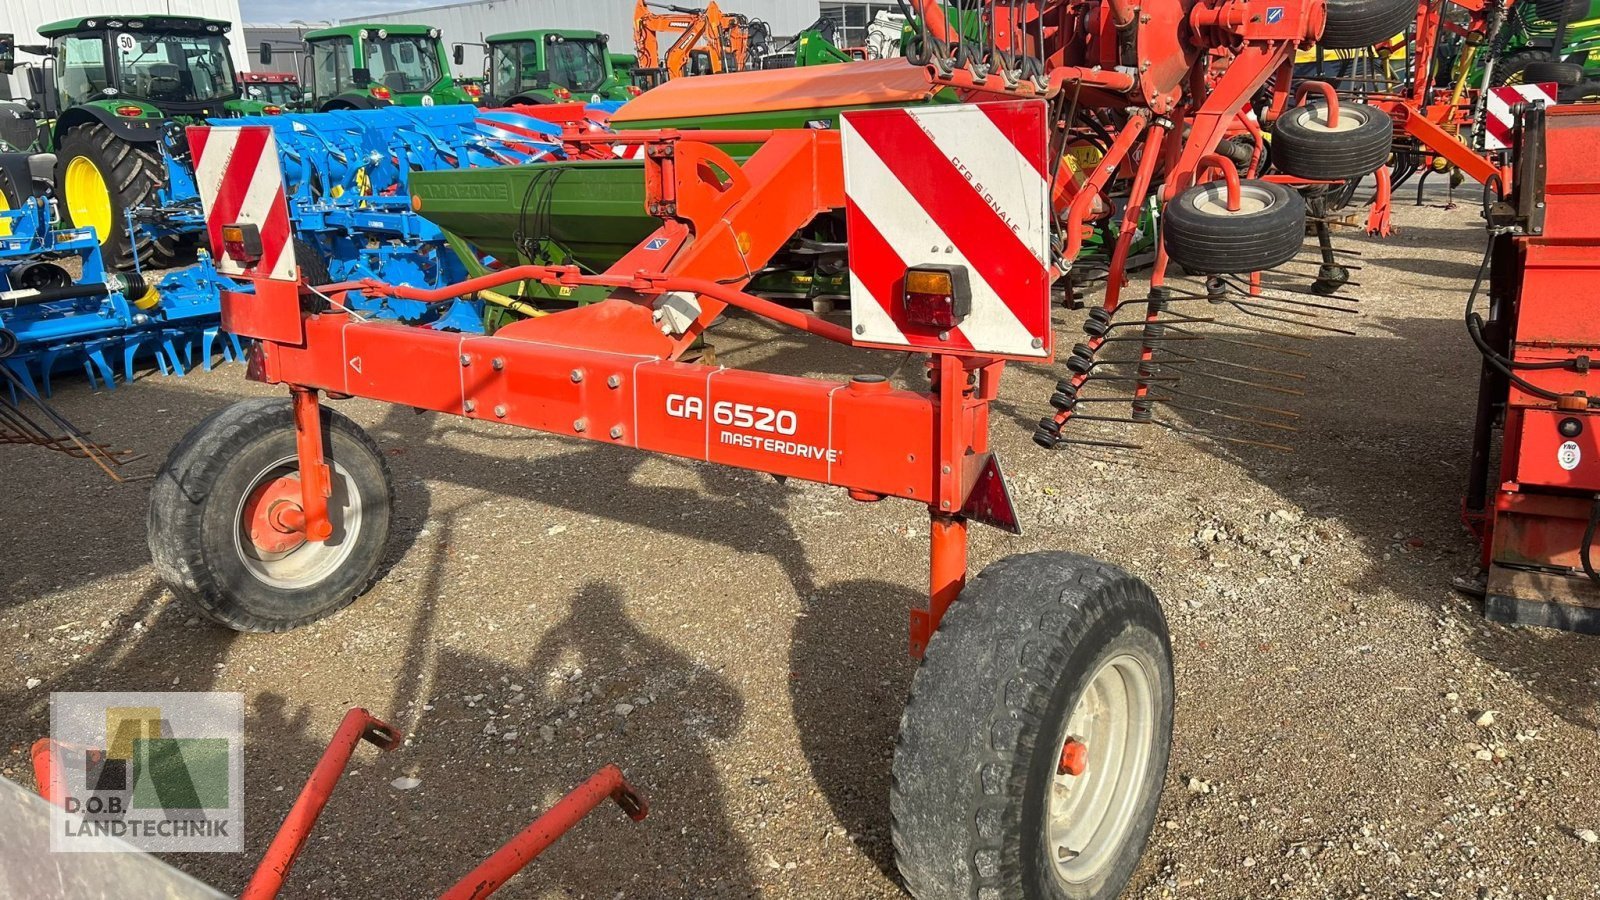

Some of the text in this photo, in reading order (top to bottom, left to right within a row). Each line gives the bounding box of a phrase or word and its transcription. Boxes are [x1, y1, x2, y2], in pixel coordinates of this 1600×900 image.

[120, 36, 132, 49] 50
[951, 156, 974, 182] CFG
[421, 184, 508, 200] AMAZONE
[666, 393, 797, 436] GA 6520
[720, 431, 838, 462] MASTERDRIVE
